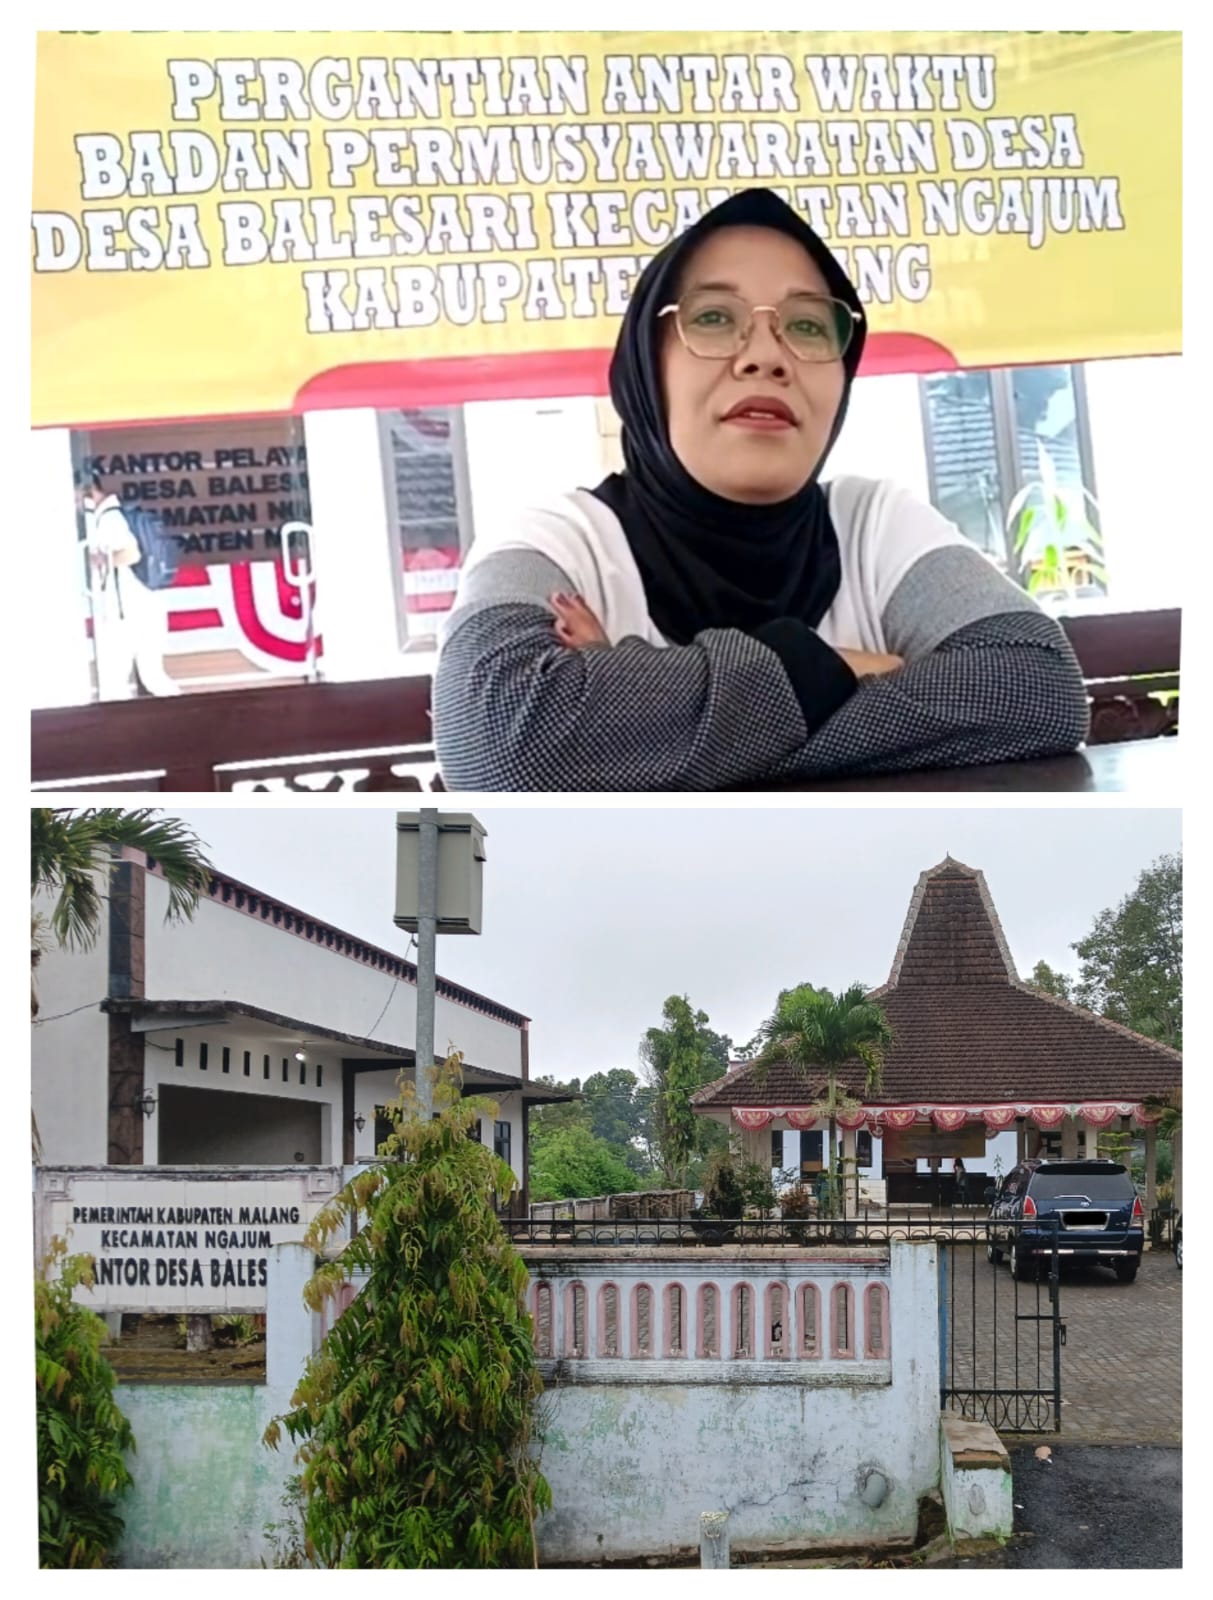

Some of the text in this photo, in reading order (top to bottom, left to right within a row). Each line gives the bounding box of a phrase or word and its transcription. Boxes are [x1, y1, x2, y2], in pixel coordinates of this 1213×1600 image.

[168, 54, 997, 120] PERGANTIAN ANTAR WAKTU
[76, 114, 1085, 200] BADAN PERMUSYAWARATAN DESA
[32, 176, 1126, 273] DESA BALESARI KECATAN NGAJUM
[302, 253, 641, 333] KABUPATE
[85, 451, 203, 475] KANTOR
[122, 479, 197, 501] DESA
[72, 1206, 300, 1225] PEMERINTAH KABUPATEN MALANG
[100, 1230, 273, 1249] KECAMATAN NGAJUM
[156, 1258, 204, 1288] DESA
[210, 1258, 268, 1288] BALES
